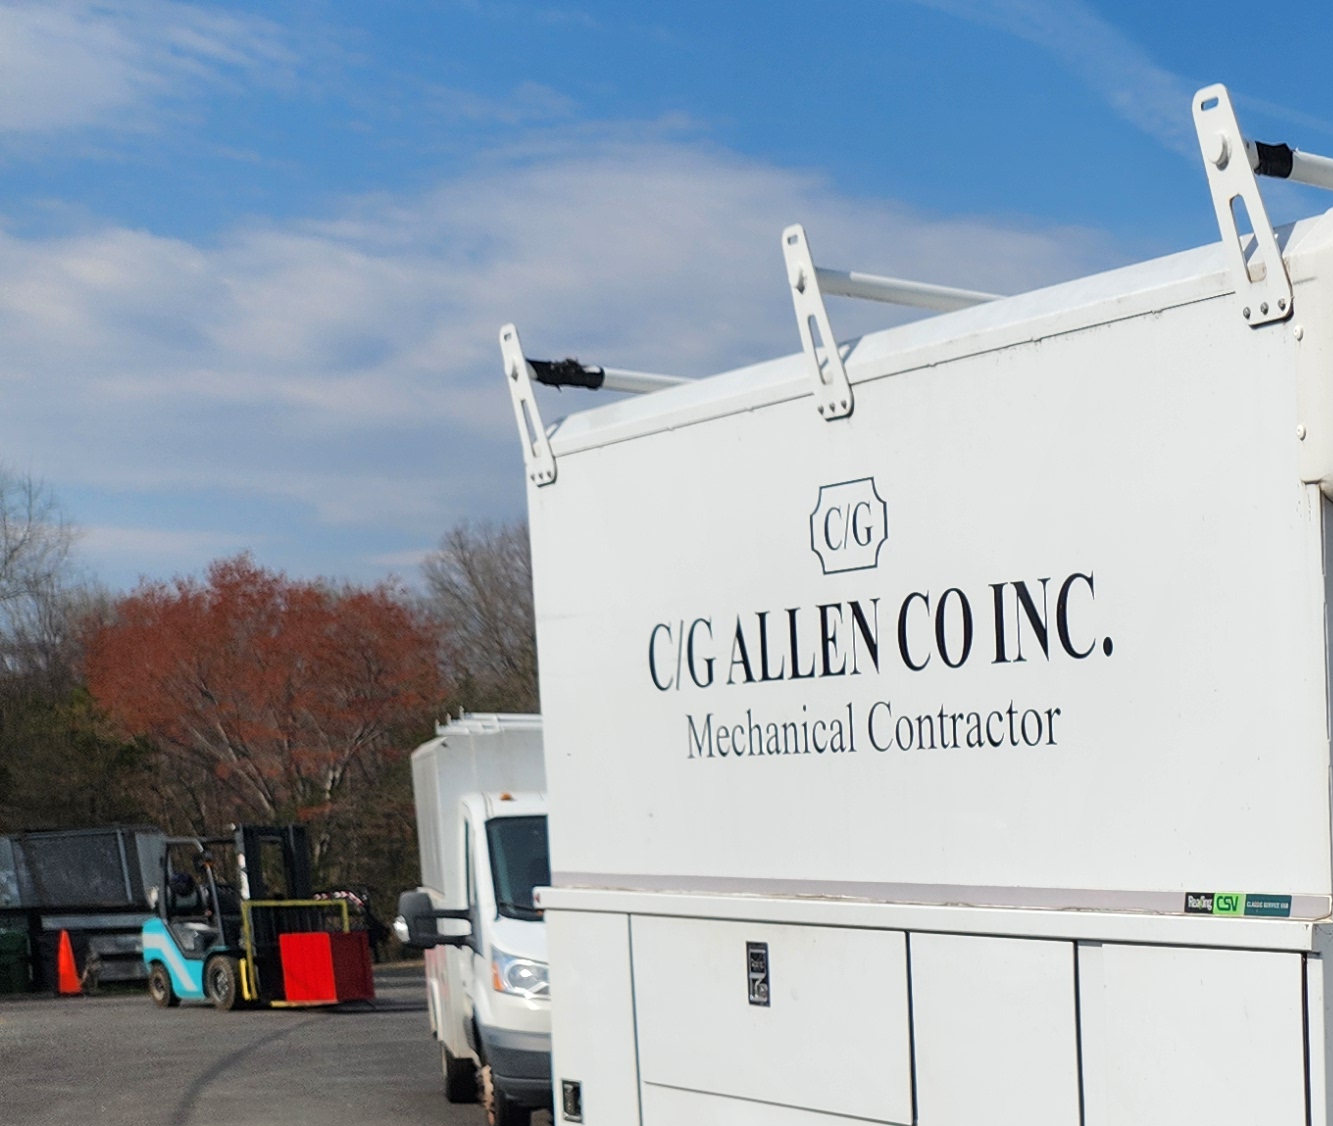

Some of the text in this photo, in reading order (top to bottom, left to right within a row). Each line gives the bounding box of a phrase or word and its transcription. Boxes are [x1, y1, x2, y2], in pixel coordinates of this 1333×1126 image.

[824, 501, 873, 551] C/G
[648, 570, 1114, 692] C/G ALLEN CO INC.
[686, 699, 1062, 759] Mechanical Contractor
[1216, 895, 1239, 912] CSV
